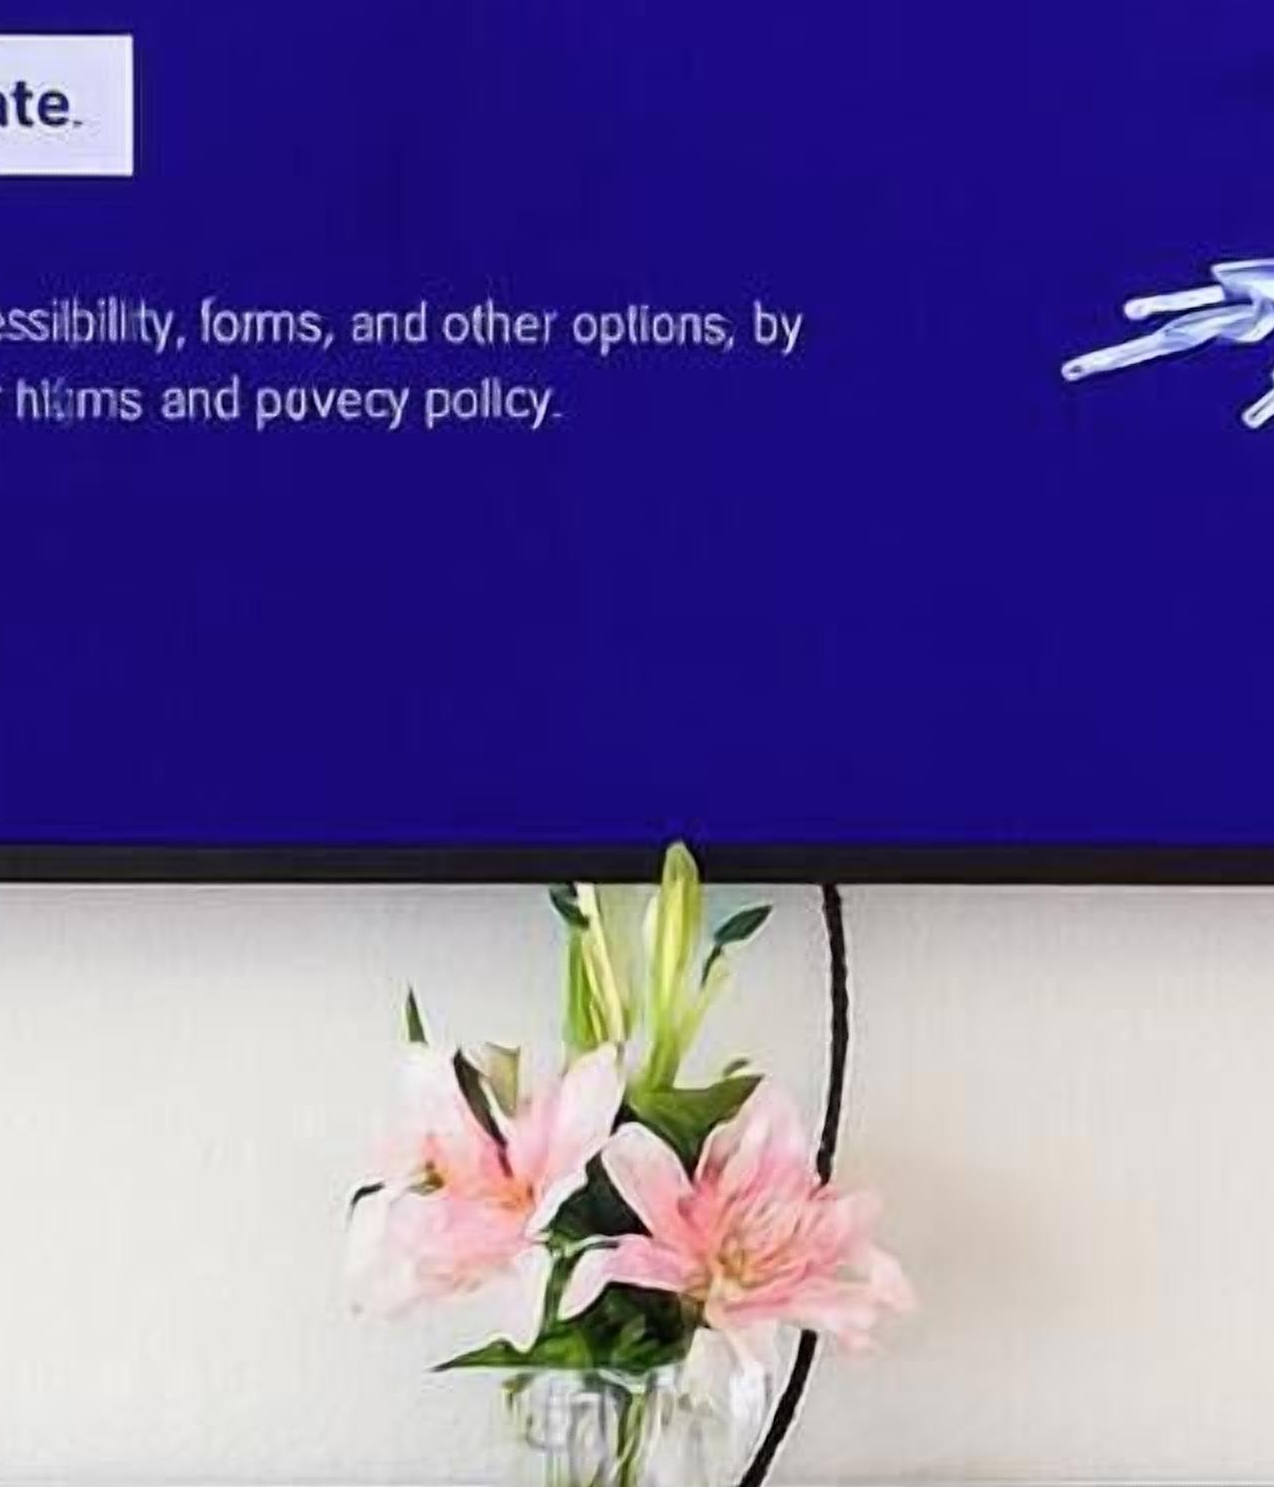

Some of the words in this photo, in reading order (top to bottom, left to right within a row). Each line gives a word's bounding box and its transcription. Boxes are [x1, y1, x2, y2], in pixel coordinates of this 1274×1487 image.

[352, 300, 427, 343] and
[442, 298, 557, 345] other
[753, 300, 804, 355] by
[161, 374, 240, 420] and
